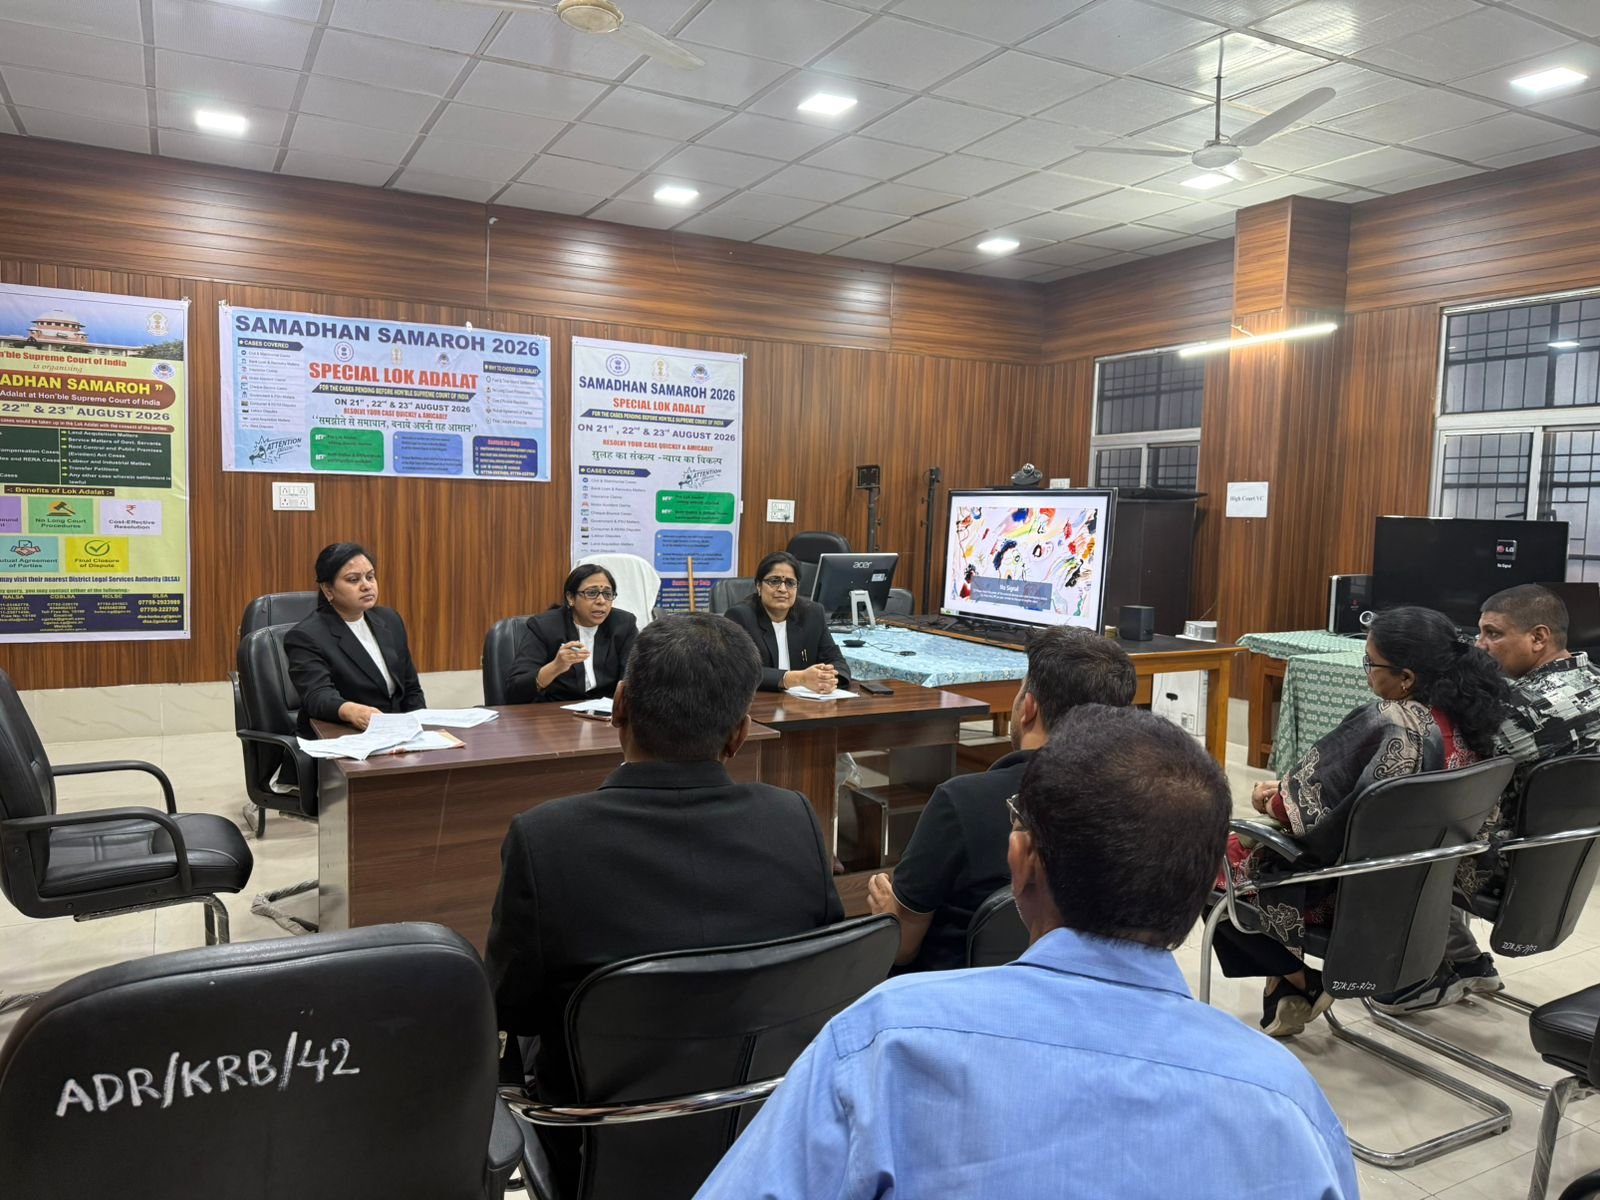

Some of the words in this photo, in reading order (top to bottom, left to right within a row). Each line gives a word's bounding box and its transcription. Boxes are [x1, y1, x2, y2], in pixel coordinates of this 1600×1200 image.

[235, 315, 370, 342] SAMADHAN
[377, 327, 485, 352] SAMAROH
[492, 338, 540, 357] 2026
[263, 341, 289, 349] COVERED
[23, 351, 65, 362] Supreme
[66, 355, 92, 365] Court
[93, 358, 102, 366] of
[103, 358, 127, 367] India
[309, 361, 380, 382] SPECIAL
[383, 367, 415, 385] LOK
[418, 370, 479, 390] ADALAT
[67, 377, 150, 395] SAMAROH
[330, 384, 339, 392] THE
[339, 385, 355, 393] CASES
[579, 375, 647, 394] SAMADHAN
[650, 381, 707, 399] SAMAROH
[710, 387, 736, 401] 2026
[0, 389, 26, 398] Adalat
[71, 393, 107, 404] Supreme
[108, 396, 131, 405] Court
[33, 405, 45, 414] &
[77, 407, 133, 419] AUGUST
[135, 411, 170, 420] 2026
[334, 398, 348, 406] ON
[415, 403, 449, 412] AUGUST
[451, 405, 471, 413] 2026
[343, 407, 366, 415] RESOLVE
[367, 408, 381, 416] YOUR
[381, 409, 394, 417] CASE
[613, 397, 651, 411] SPECIAL
[653, 401, 671, 411] LOK
[672, 403, 705, 414] ADALAT
[434, 421, 446, 431] राह
[577, 423, 594, 432] ON
[642, 428, 650, 436] &
[672, 430, 712, 440] AUGUST
[713, 433, 736, 441] 2026
[267, 437, 302, 452] ATTENTION
[602, 438, 627, 447] RESOLVE
[643, 441, 658, 449] CASE
[592, 450, 614, 461] सुलह
[615, 451, 627, 460] का
[683, 455, 695, 464] का
[852, 561, 873, 569] acer
[55, 1031, 361, 1118] ADR/KRB/42
